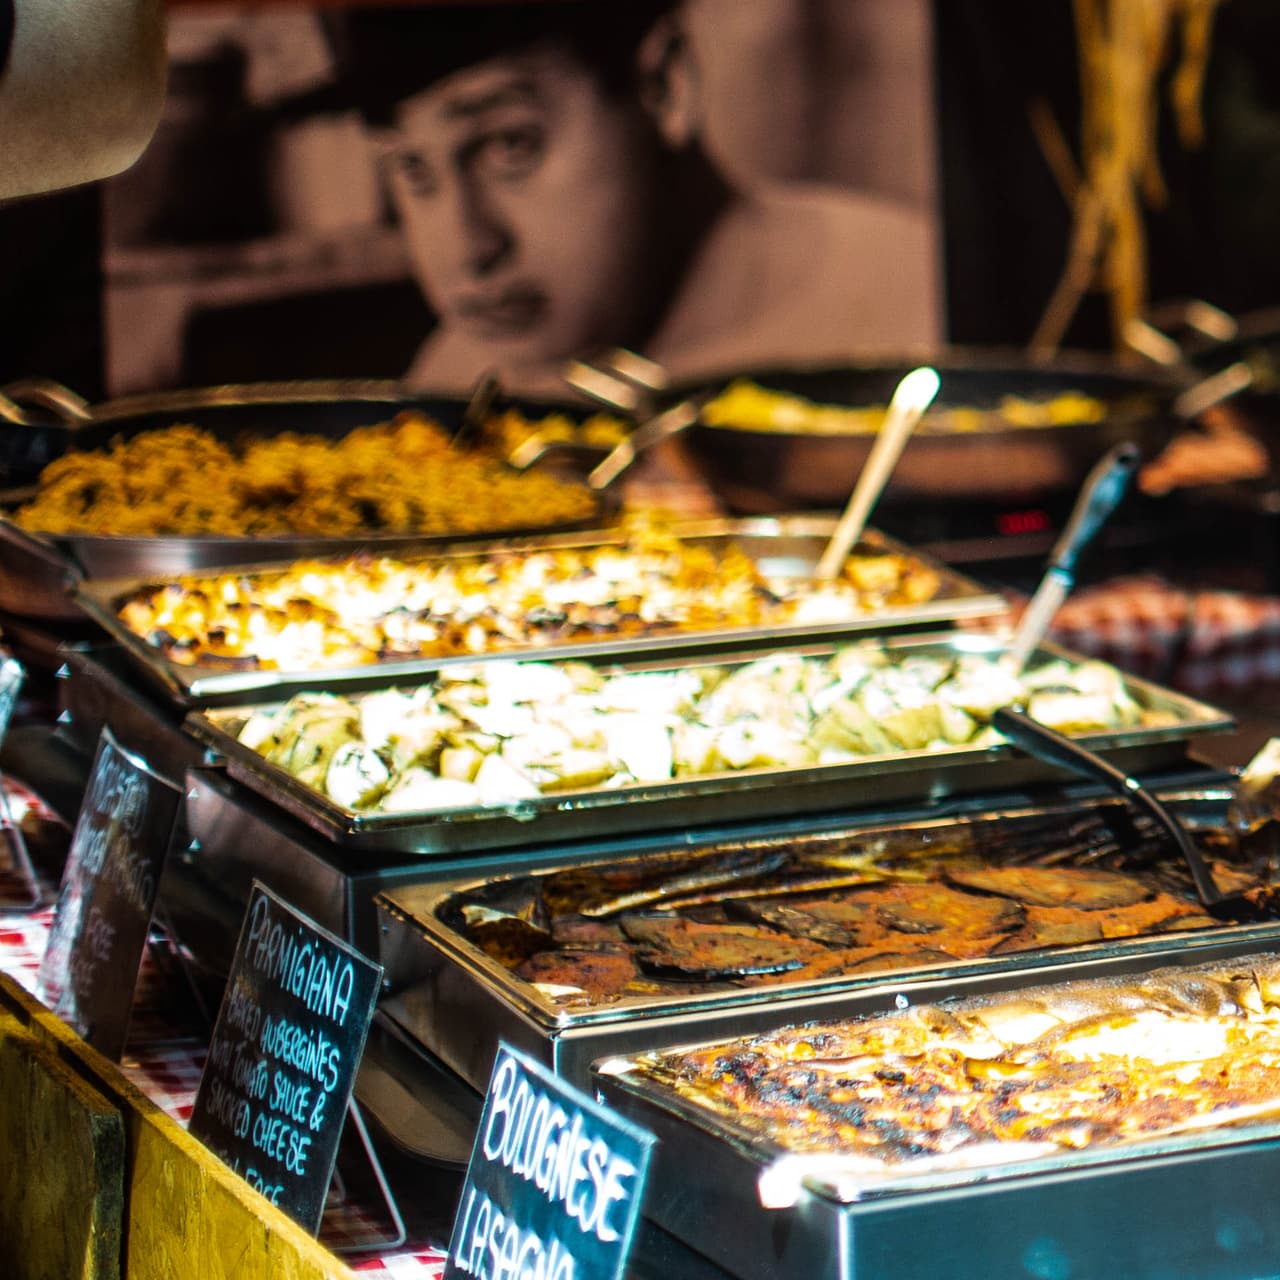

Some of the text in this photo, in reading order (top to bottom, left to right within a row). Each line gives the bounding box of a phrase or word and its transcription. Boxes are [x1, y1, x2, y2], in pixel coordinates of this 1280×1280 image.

[269, 1070, 311, 1123] SAUCE
[309, 1092, 326, 1132] &
[252, 1112, 312, 1176] CHEESE
[483, 1057, 636, 1242] BOLOGNESE
